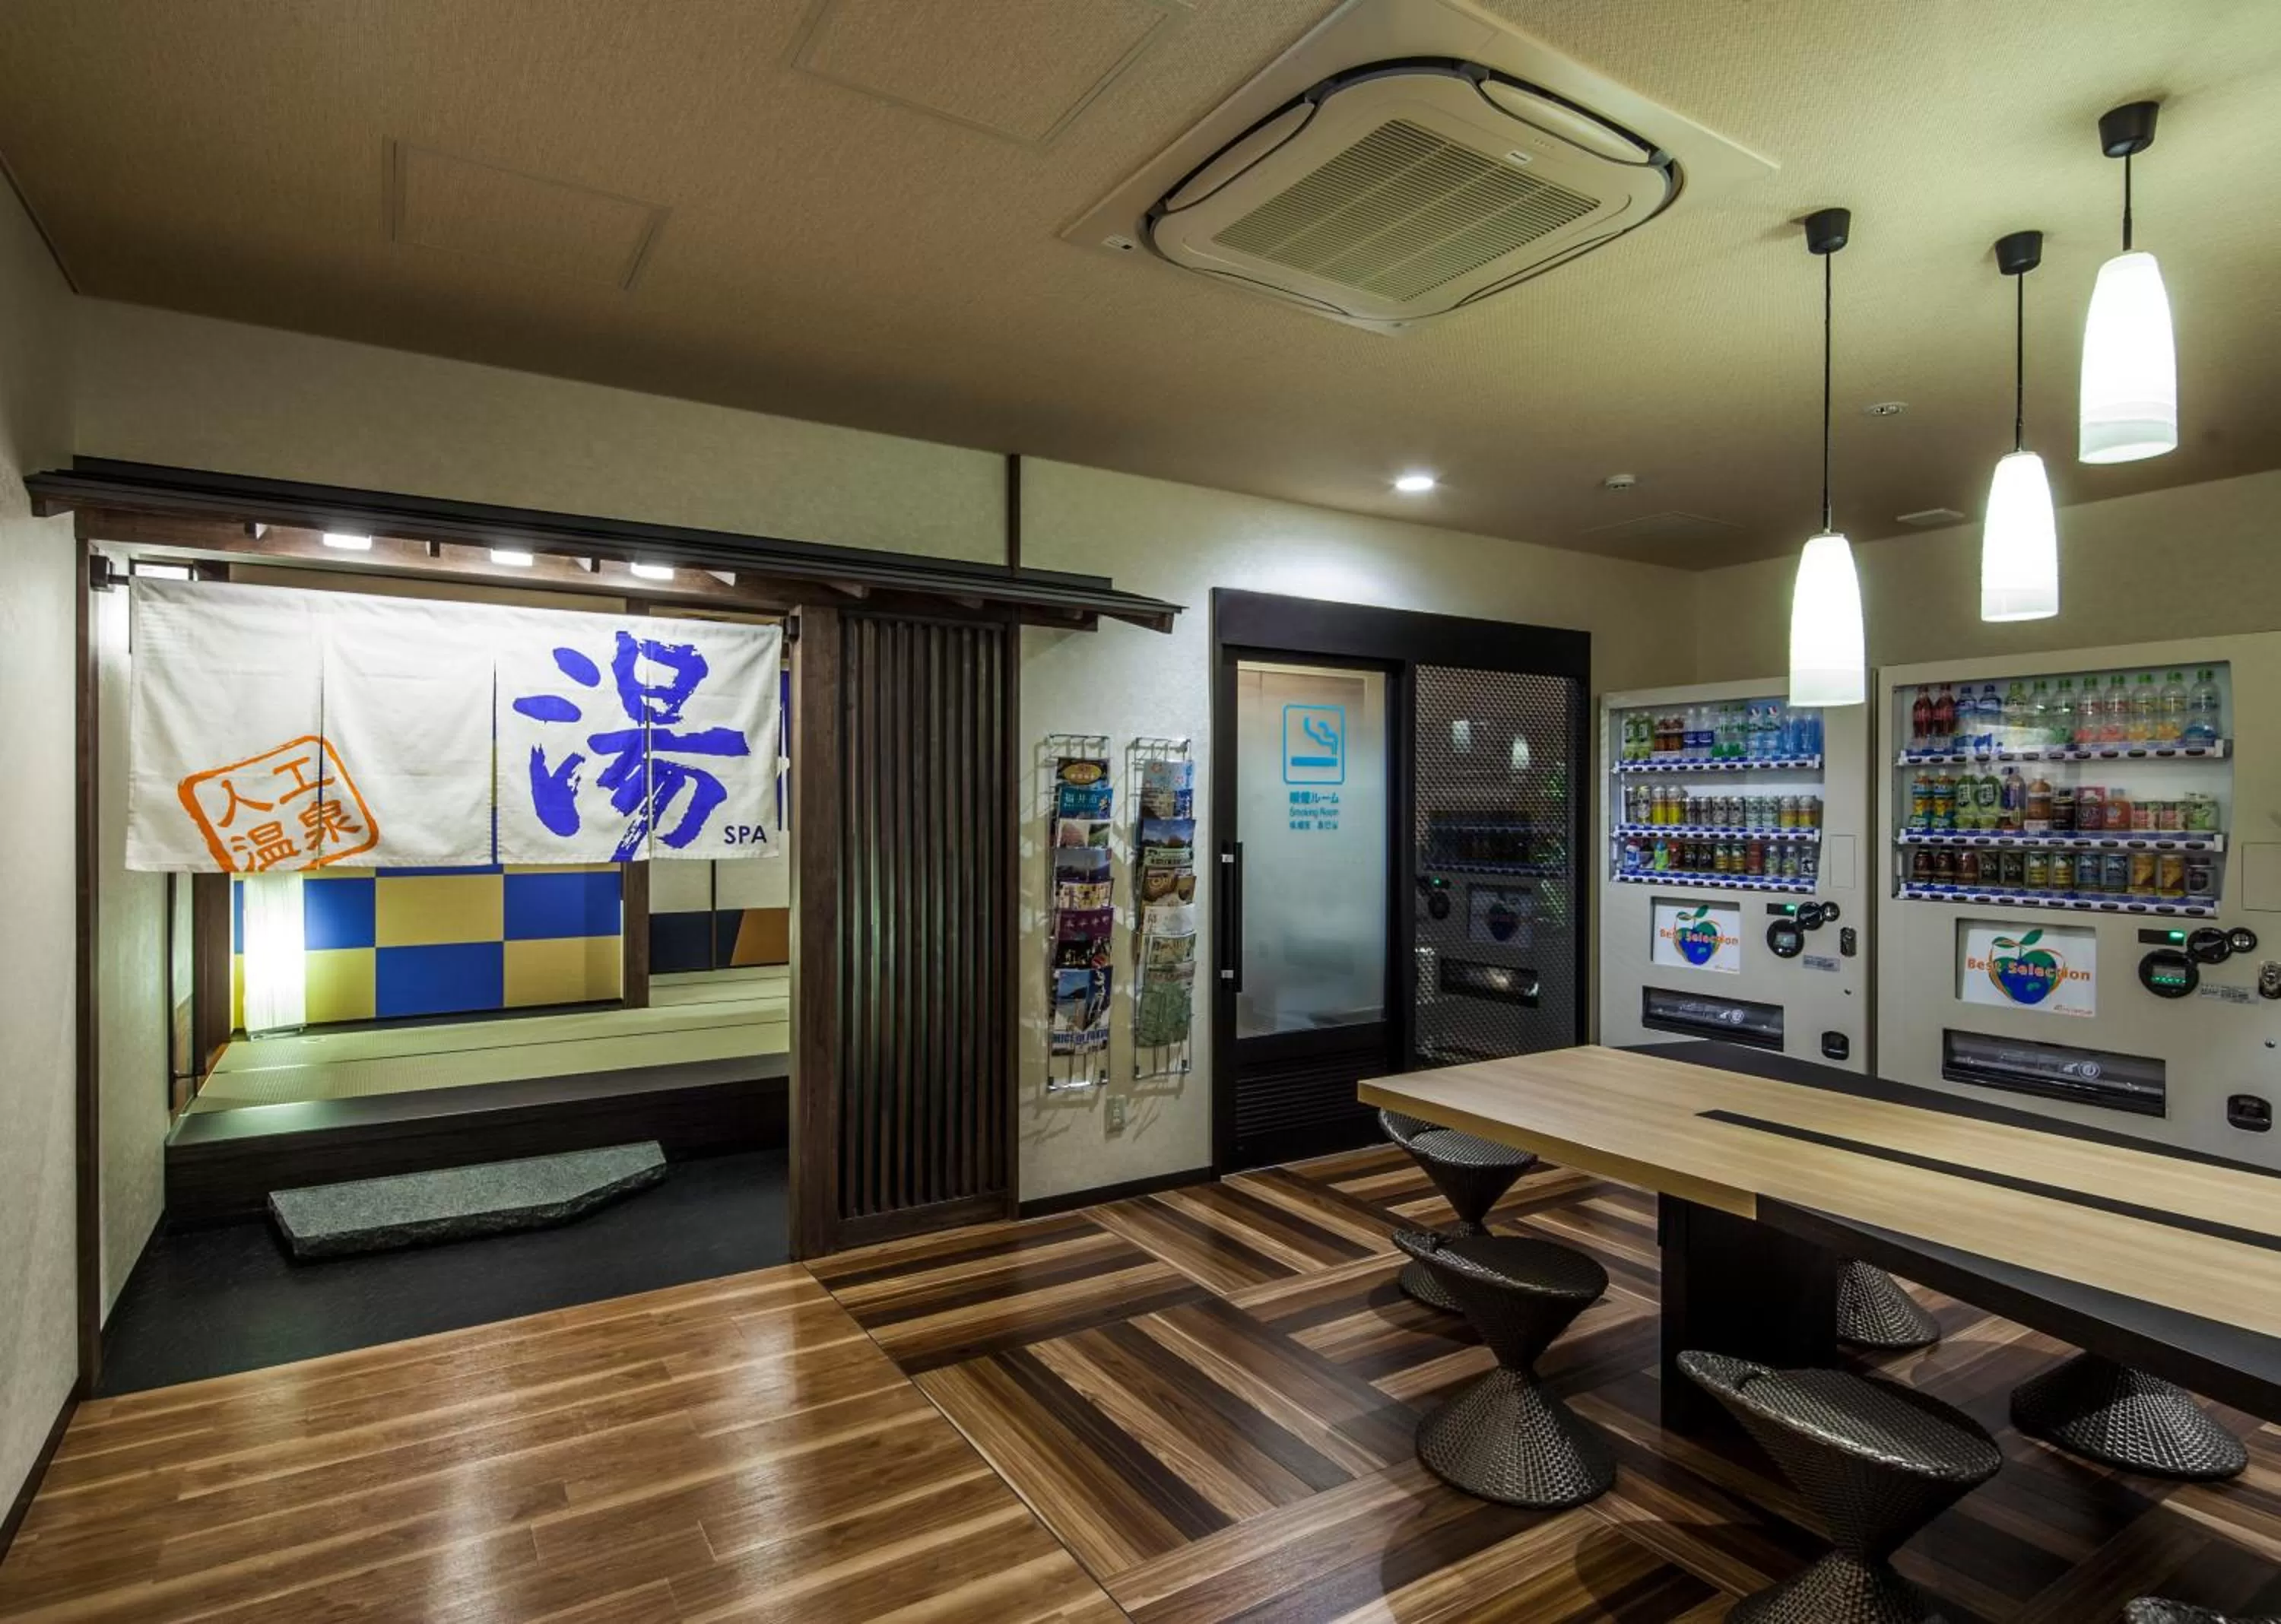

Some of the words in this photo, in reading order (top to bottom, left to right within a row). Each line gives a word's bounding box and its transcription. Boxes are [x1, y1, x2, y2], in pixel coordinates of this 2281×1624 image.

[512, 630, 751, 863] 湯
[217, 756, 336, 828] 人工
[230, 799, 363, 872] 温泉
[724, 825, 767, 845] SPA
[1967, 957, 2002, 973] Best
[2007, 960, 2090, 982] Selection
